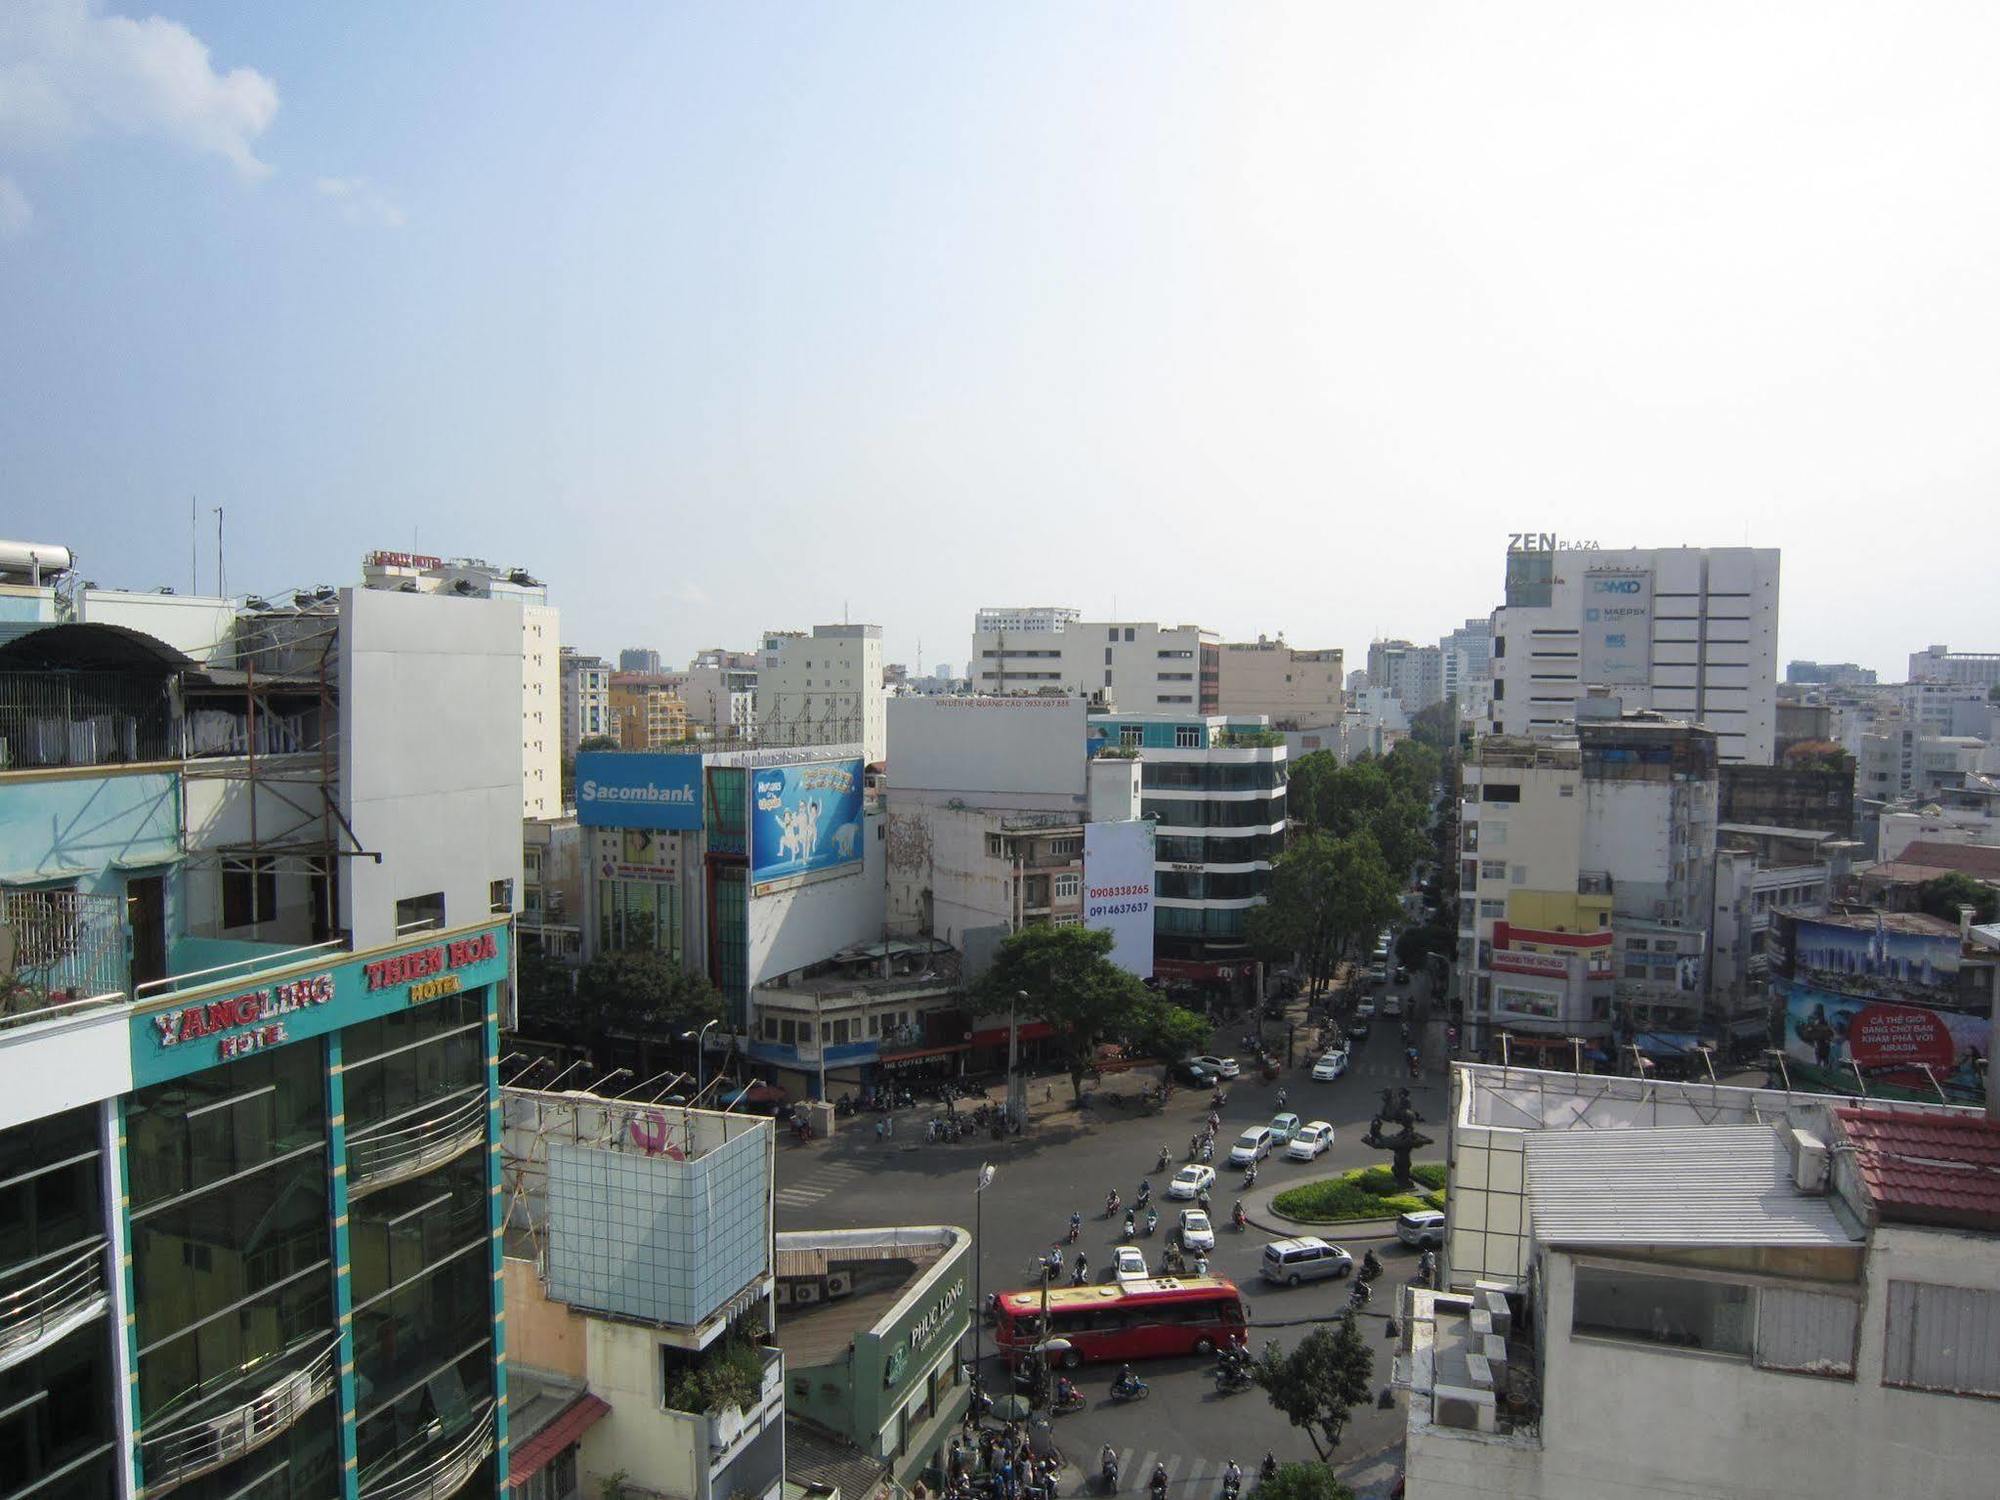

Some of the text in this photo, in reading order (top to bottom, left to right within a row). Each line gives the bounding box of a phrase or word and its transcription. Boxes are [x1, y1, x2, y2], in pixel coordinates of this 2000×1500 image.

[1508, 533, 1600, 551] ZEN PLAZA
[582, 780, 695, 802] Sacombank
[1090, 884, 1149, 899] 0908338265
[1090, 902, 1148, 917] 0914637637
[940, 1278, 964, 1317] LONG
